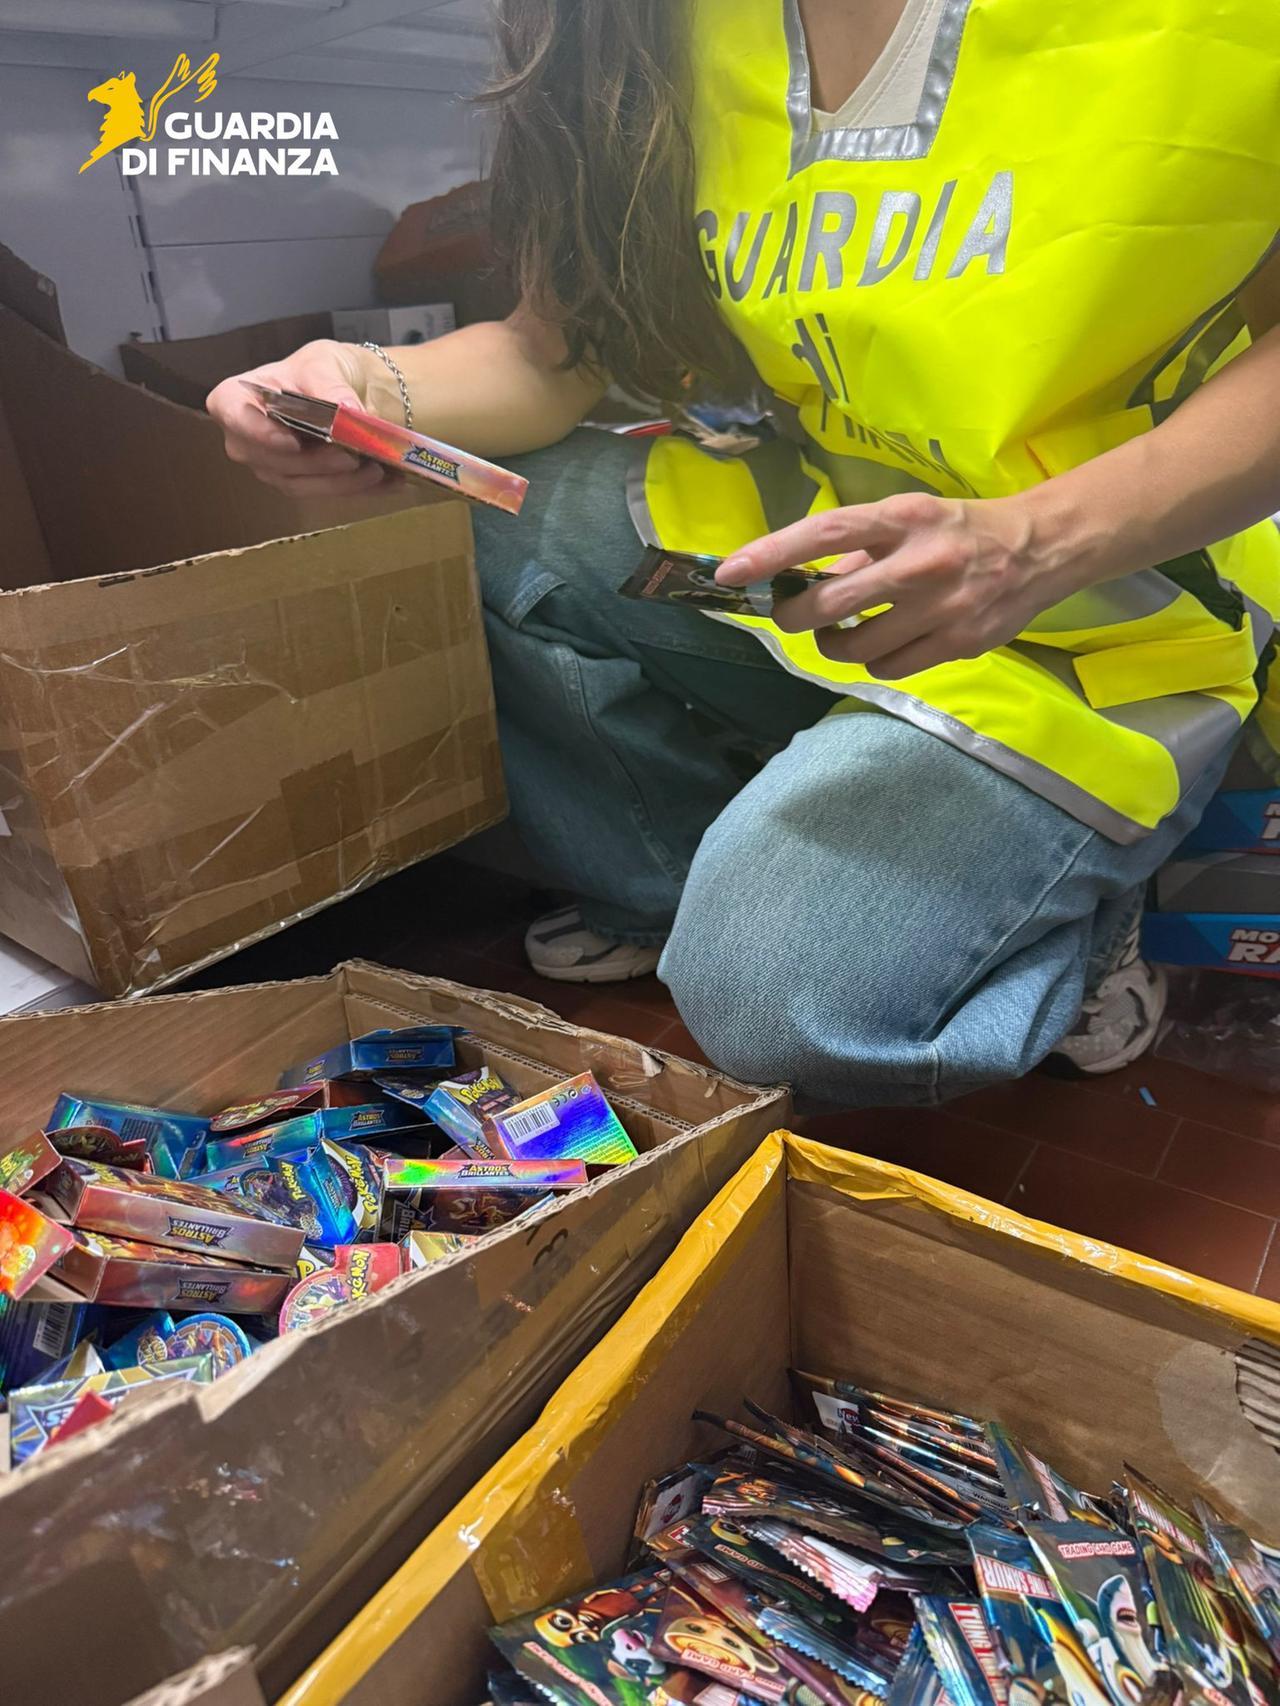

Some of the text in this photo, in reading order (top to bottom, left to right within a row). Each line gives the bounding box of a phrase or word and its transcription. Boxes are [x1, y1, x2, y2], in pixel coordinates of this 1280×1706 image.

[695, 170, 1014, 303] GUARDIA
[408, 453, 456, 478] BRILLANTES
[419, 450, 456, 471] ASTROS
[461, 1168, 509, 1176] BRILLANTES
[469, 1164, 508, 1172] ASTROS
[172, 1227, 215, 1243] ASTROS
[1059, 1544, 1094, 1558] TRADING
[1111, 1541, 1135, 1555] GAME
[954, 1608, 992, 1648] TUNG
